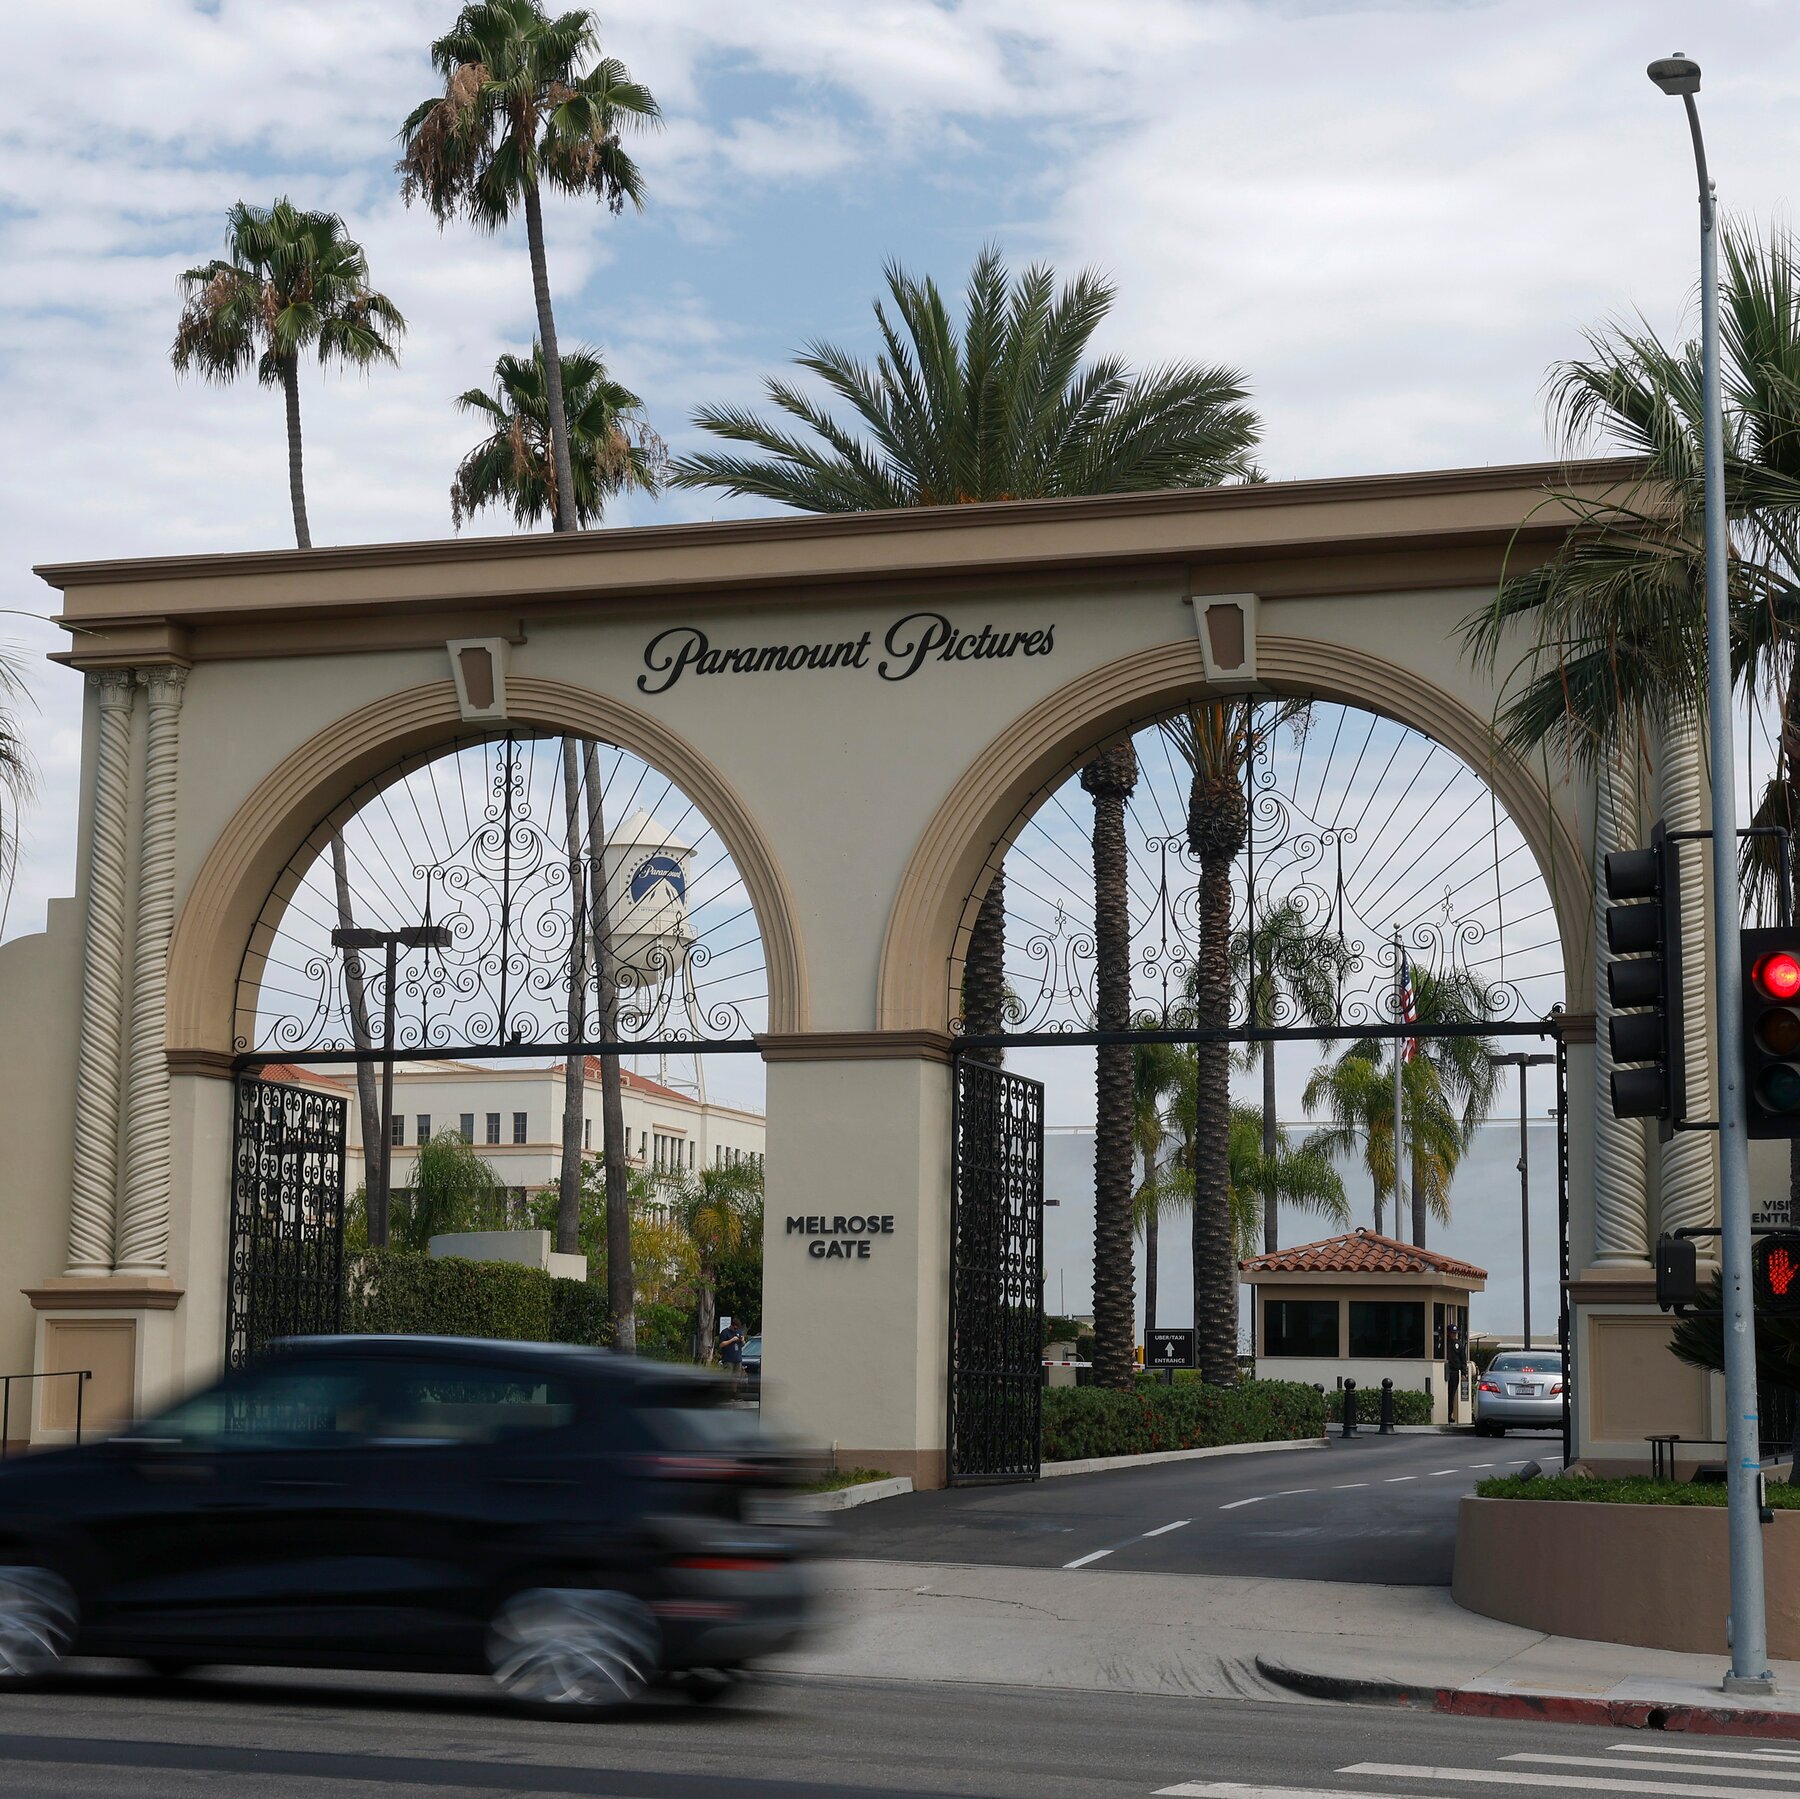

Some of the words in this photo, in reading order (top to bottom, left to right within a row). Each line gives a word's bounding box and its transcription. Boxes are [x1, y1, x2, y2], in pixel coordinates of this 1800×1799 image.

[637, 627, 870, 694] Paramount
[878, 612, 1055, 681] Pictures
[639, 864, 681, 879] Paramount
[1763, 1200, 1791, 1211] VISI
[786, 1215, 894, 1234] MELROSE
[808, 1240, 871, 1258] GATE
